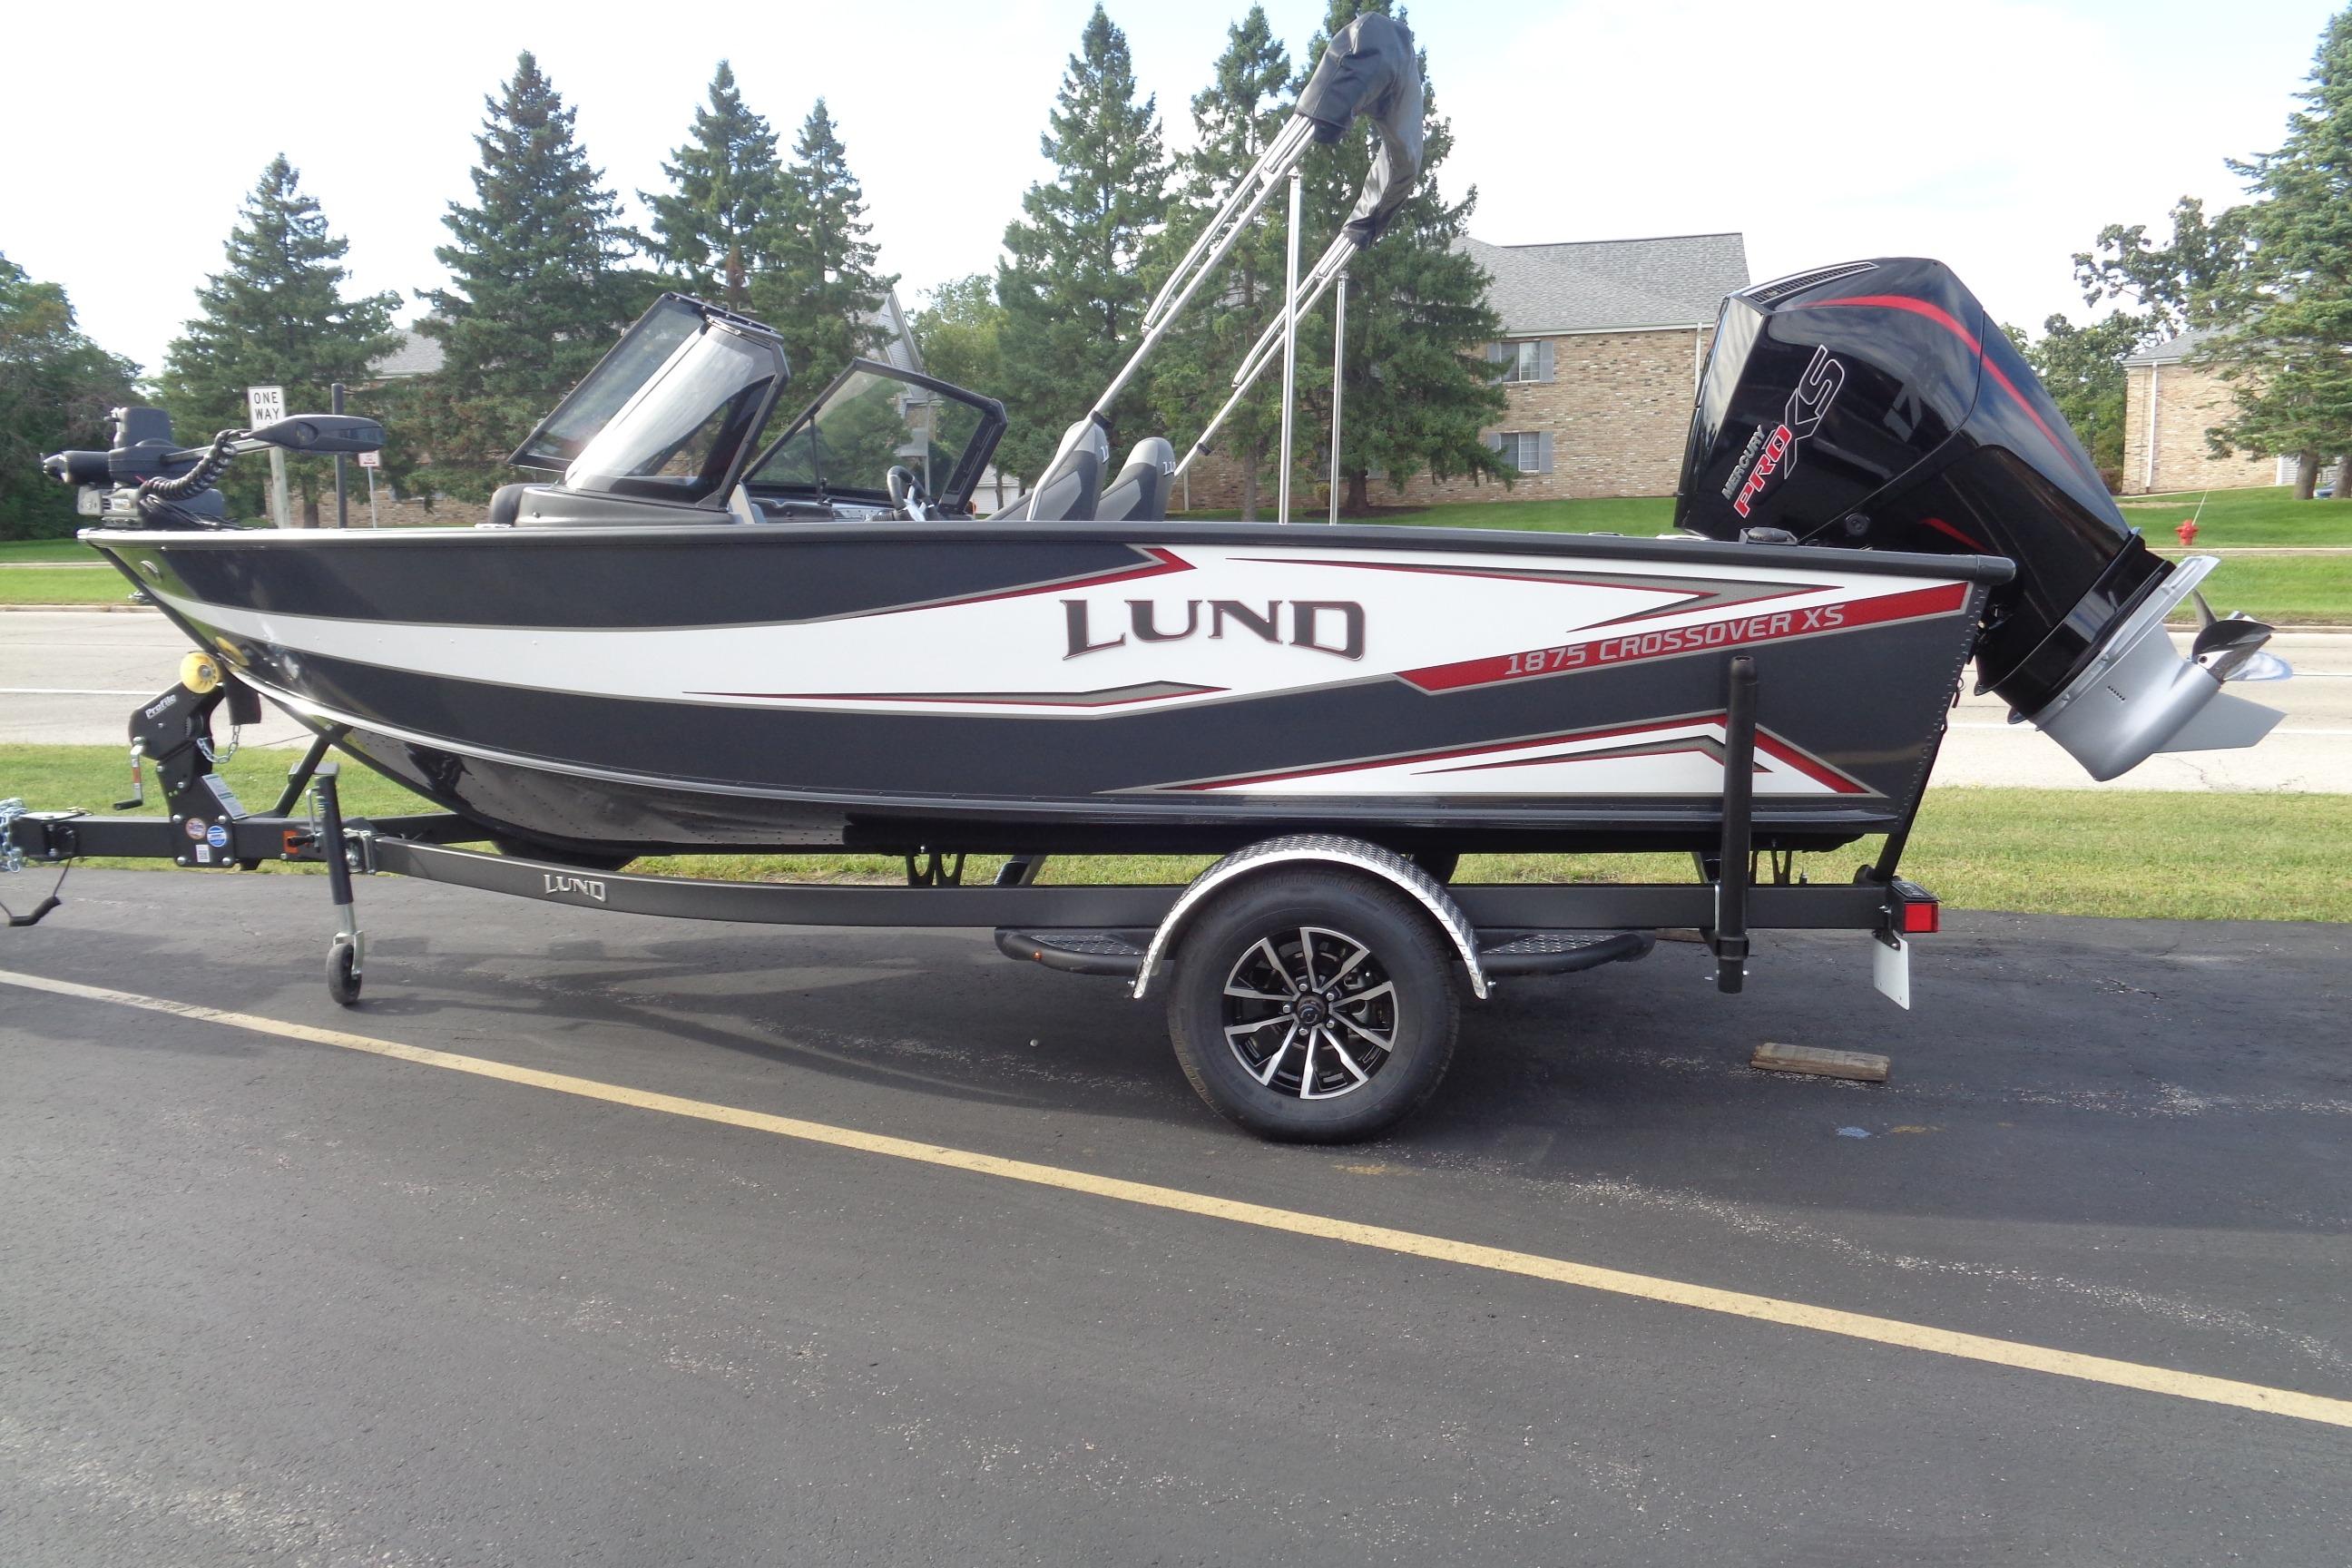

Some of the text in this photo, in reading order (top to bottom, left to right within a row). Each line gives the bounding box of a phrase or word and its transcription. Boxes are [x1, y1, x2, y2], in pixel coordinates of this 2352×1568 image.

[254, 392, 279, 404] ONE
[255, 408, 279, 420] WAY
[1721, 424, 1766, 500] MERCURY
[1059, 599, 1366, 662] LUND
[1504, 604, 1845, 675] 1875 CROSSOVER XS
[544, 874, 606, 902] LUND
